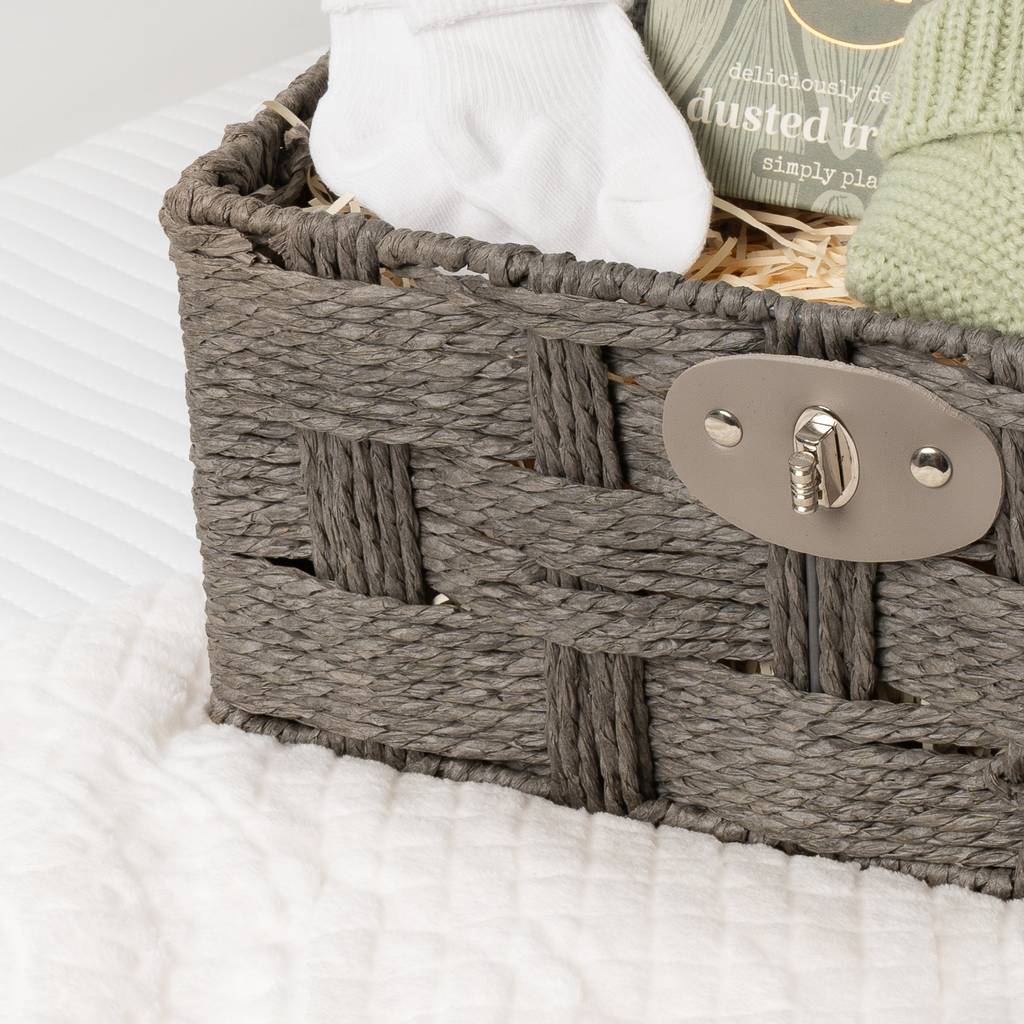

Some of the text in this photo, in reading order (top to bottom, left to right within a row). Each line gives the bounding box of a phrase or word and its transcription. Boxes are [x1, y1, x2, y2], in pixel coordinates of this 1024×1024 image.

[729, 62, 863, 104] deliciously
[687, 87, 830, 145] dusted
[762, 155, 879, 190] simply pla
